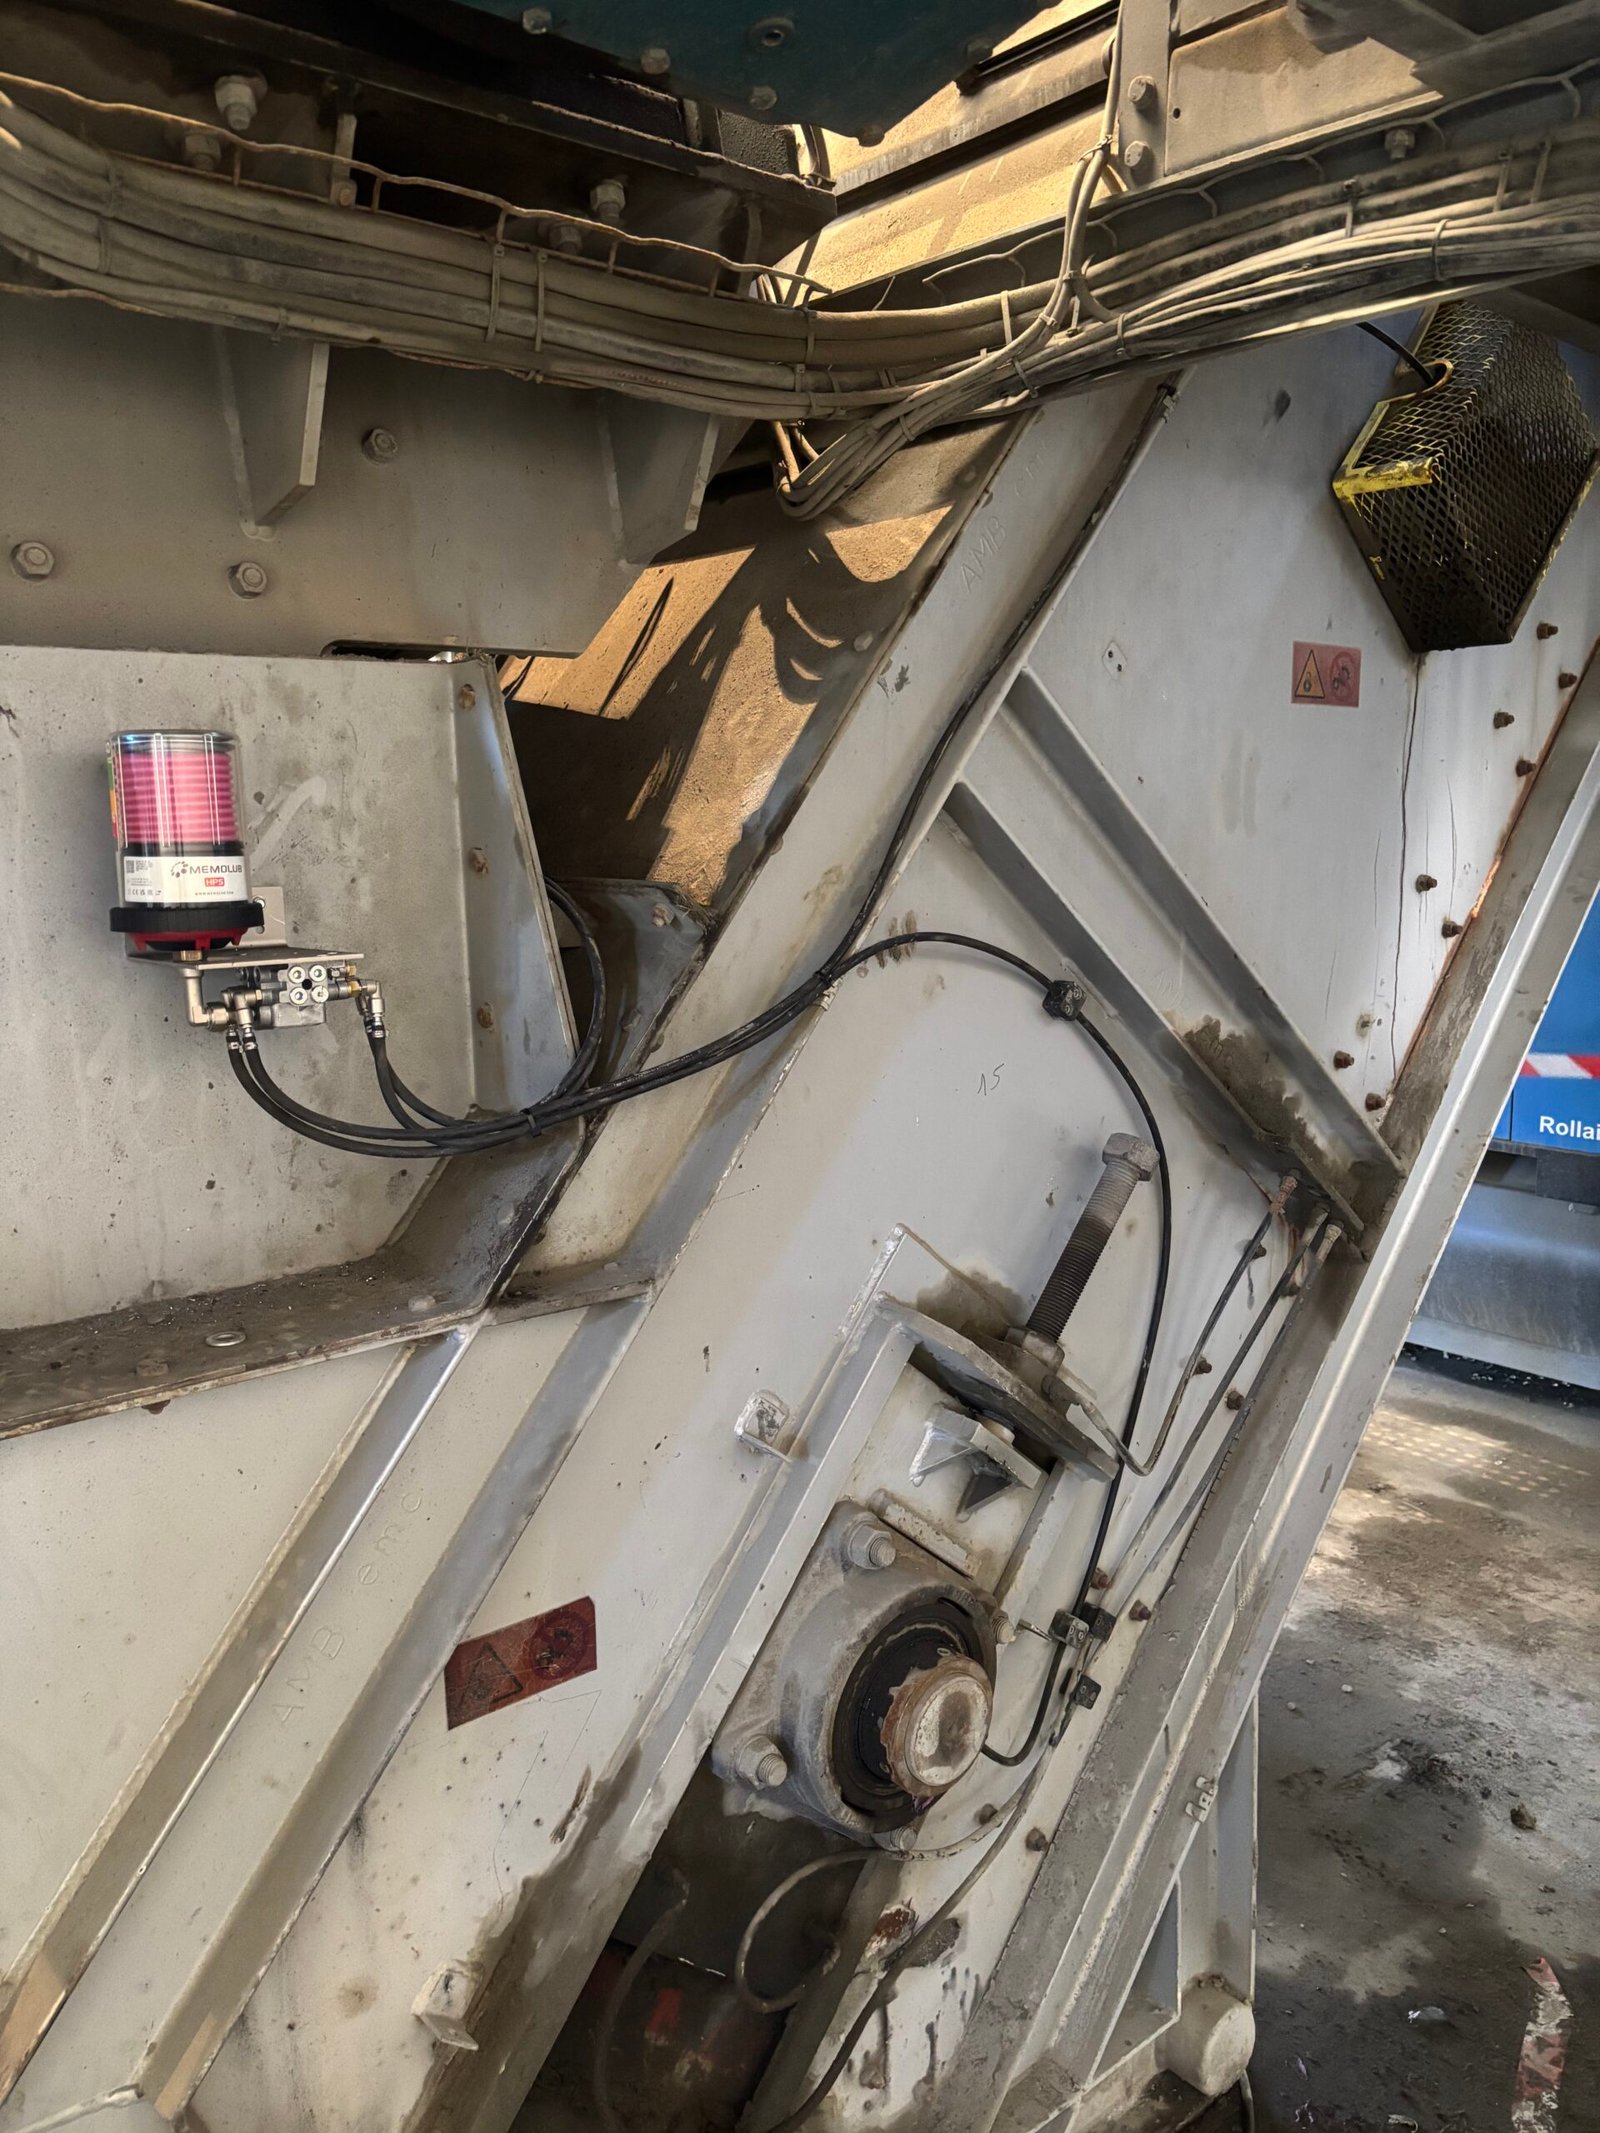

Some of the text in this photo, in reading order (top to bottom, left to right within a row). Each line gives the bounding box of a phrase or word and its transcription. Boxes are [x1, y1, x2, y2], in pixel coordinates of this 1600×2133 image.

[189, 864, 243, 875] MEMOLUB
[977, 1062, 1005, 1097] 15
[1539, 1115, 1600, 1141] Rollai
